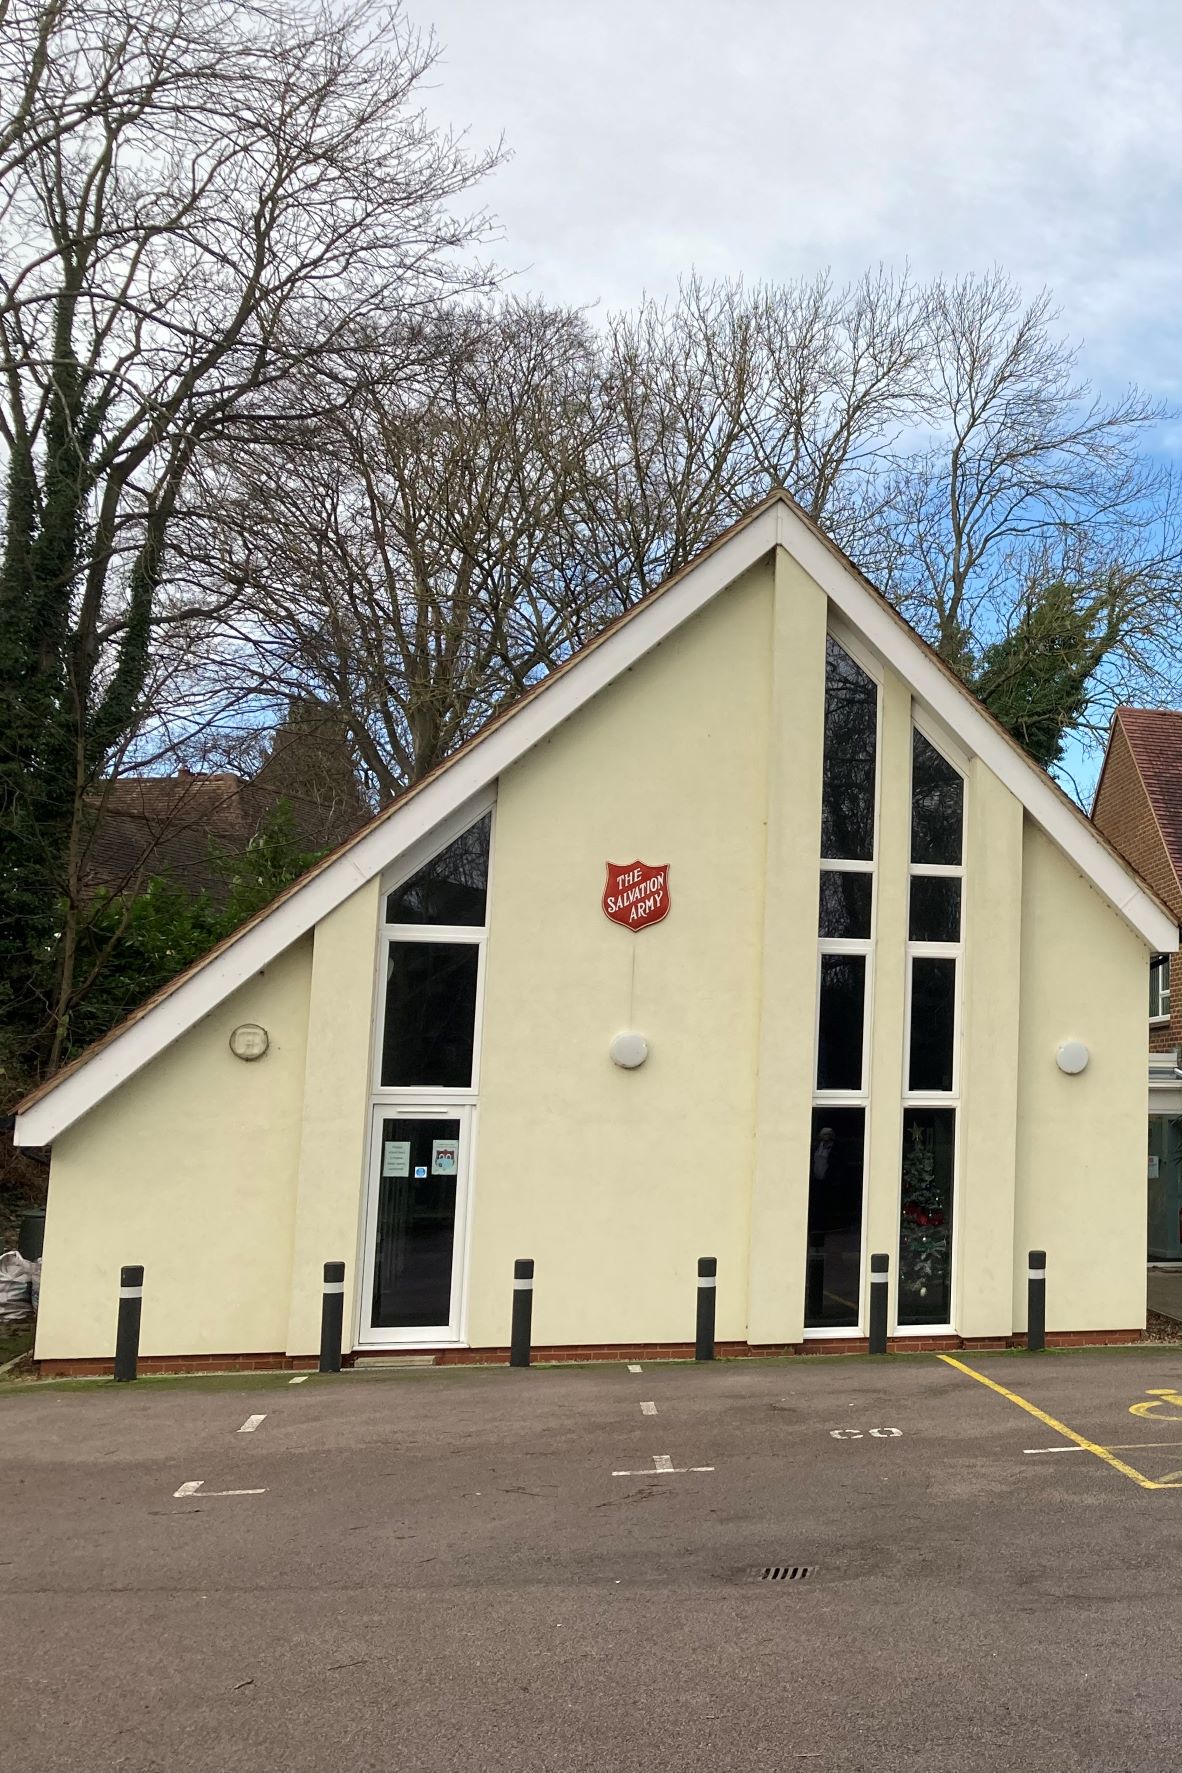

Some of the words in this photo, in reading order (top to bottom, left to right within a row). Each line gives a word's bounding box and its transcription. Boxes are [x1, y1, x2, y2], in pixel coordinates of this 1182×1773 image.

[607, 872, 664, 913] SALVATION
[617, 868, 642, 890] THE
[629, 890, 663, 922] ARMY
